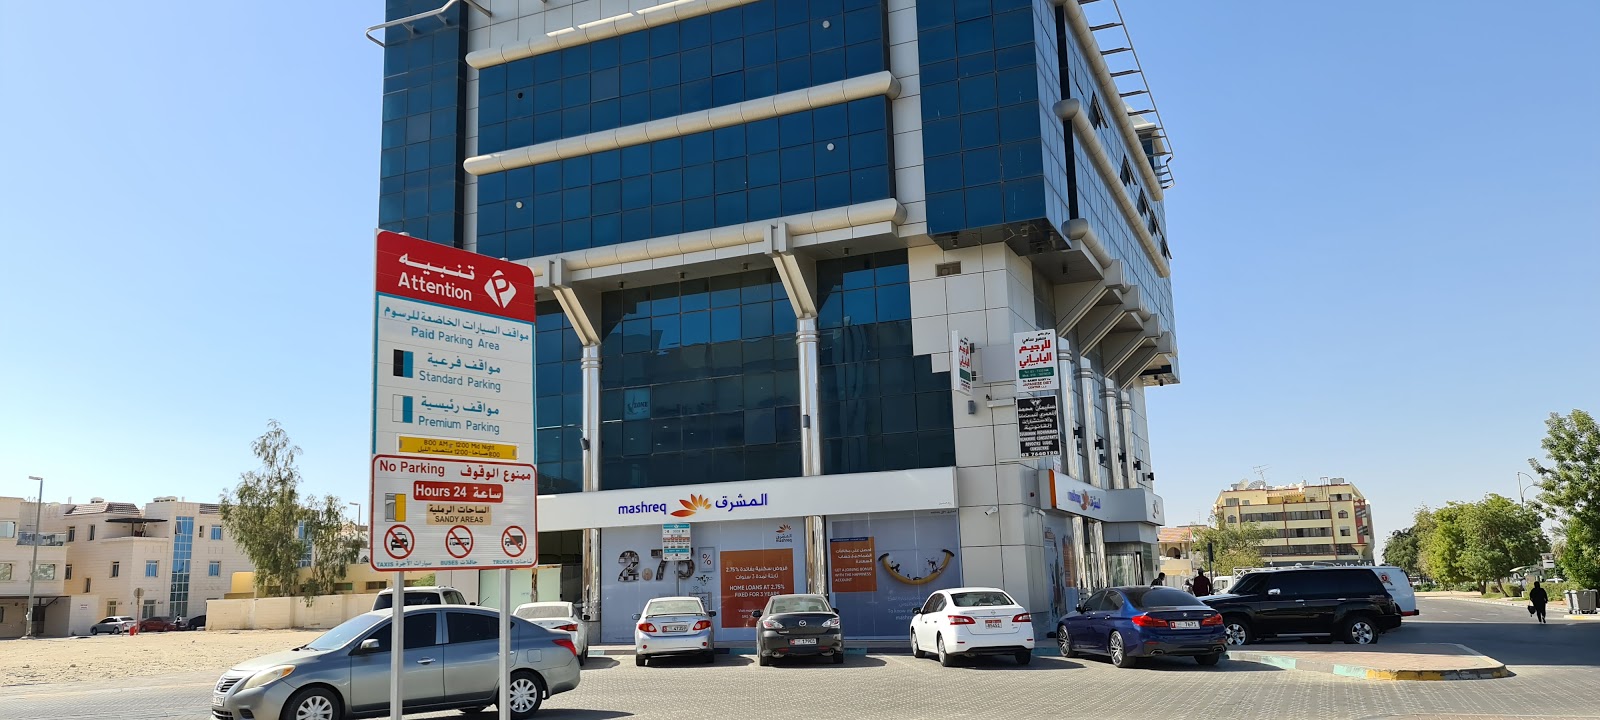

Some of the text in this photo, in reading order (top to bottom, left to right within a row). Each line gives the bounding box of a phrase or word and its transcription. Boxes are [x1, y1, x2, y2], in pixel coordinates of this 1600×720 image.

[398, 253, 475, 280] تنبيه
[398, 272, 472, 301] Attention
[384, 306, 529, 342] مواقف السيارات الخاضعة للرسوم
[411, 326, 500, 350] Paid Parking Area
[1019, 340, 1050, 353] للرجيم
[427, 352, 501, 374] مواقف فرعية
[1019, 352, 1052, 368] الياباني
[418, 370, 501, 393] Standard Parking
[421, 396, 500, 416] مواقف رئيسية
[418, 415, 500, 435] Premium Parking
[380, 460, 445, 477] No Parking
[460, 464, 531, 482] ممنوع الوقوف
[416, 484, 502, 499] Hours 24 ساعة
[429, 504, 454, 515] الرملية
[618, 493, 768, 514] mashreq المشرق
